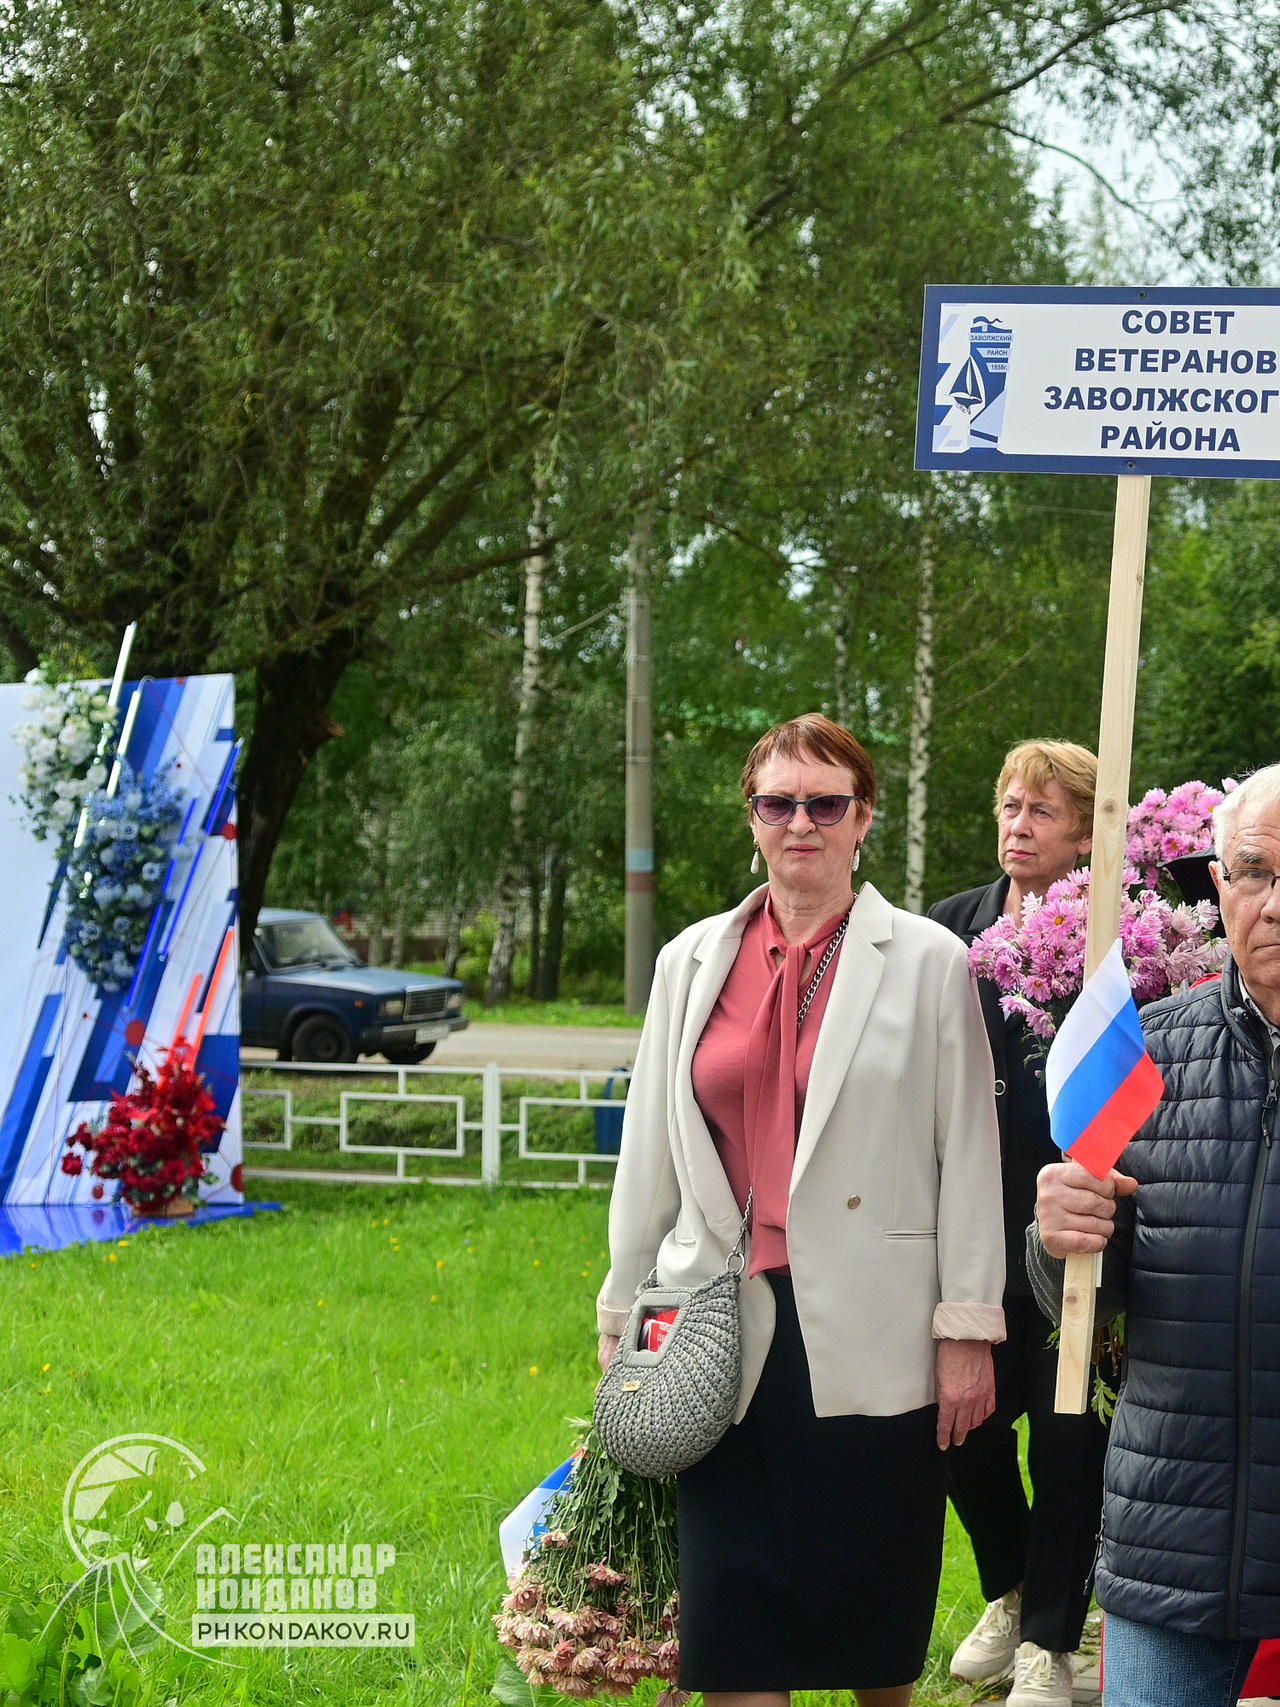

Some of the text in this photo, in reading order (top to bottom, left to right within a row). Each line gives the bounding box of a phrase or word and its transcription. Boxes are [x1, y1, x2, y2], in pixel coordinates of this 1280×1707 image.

[1121, 310, 1235, 335] СОВЕТ
[970, 334, 1012, 342] ЗАВОЛЖСКИЙ
[986, 348, 1008, 356] РАЙОН
[1074, 347, 1278, 374] ВЕТЕРАНОВ
[1100, 421, 1241, 452] РАЙОНА
